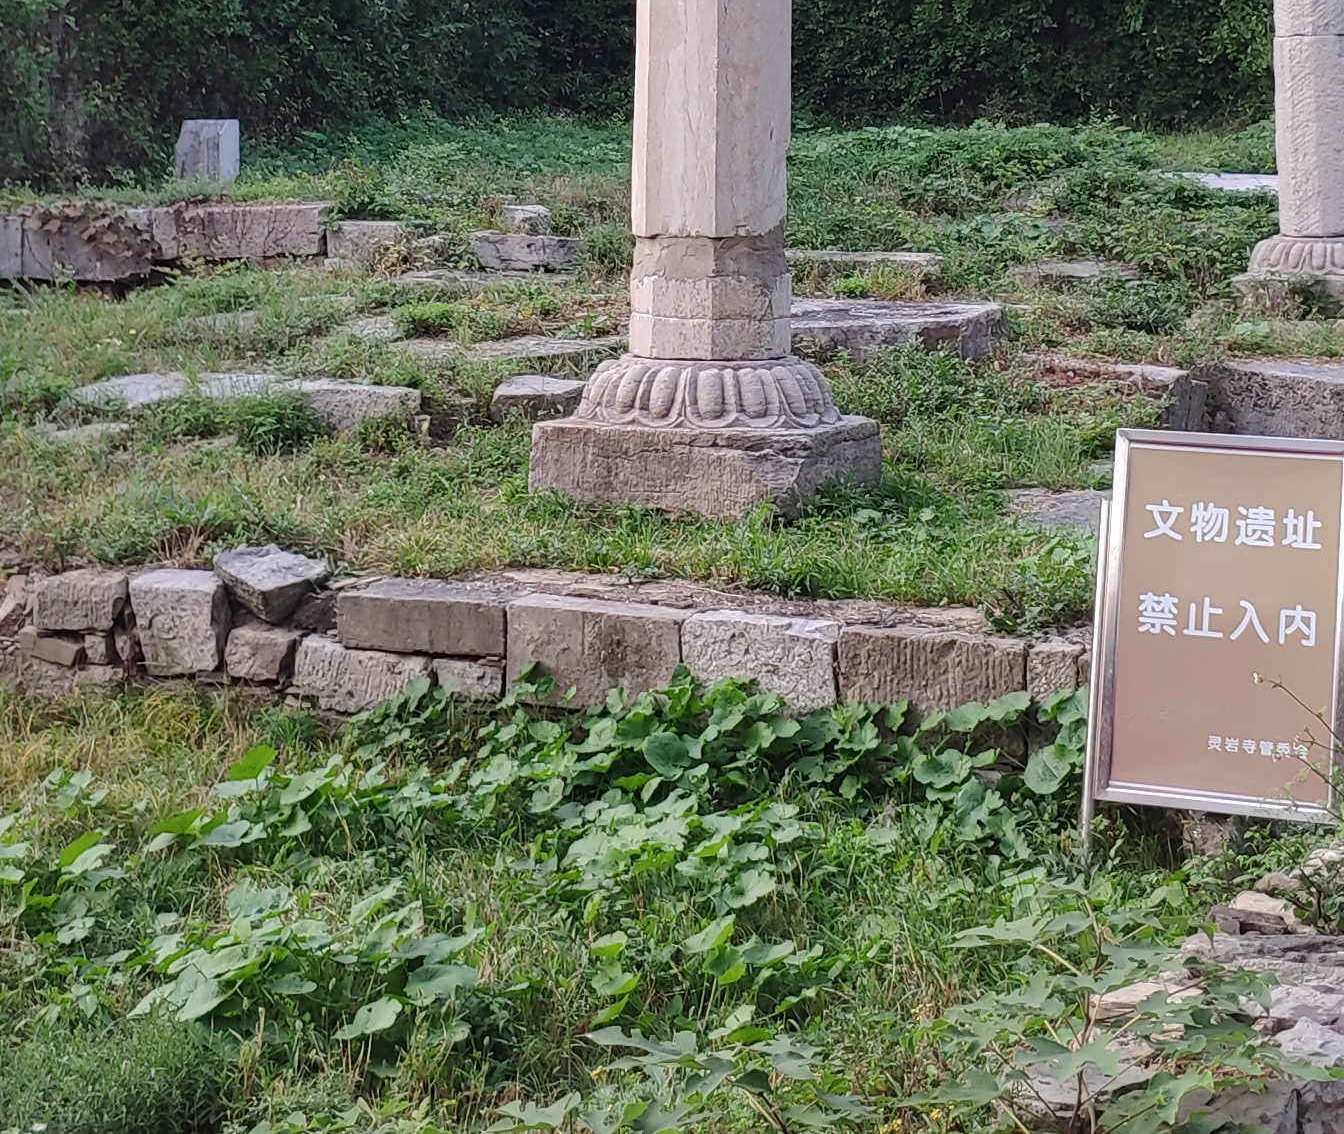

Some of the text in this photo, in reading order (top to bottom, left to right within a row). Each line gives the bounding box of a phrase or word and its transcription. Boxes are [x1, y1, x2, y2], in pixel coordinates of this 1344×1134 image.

[1143, 499, 1323, 550] 文物遗址
[1137, 591, 1317, 647] 禁止入内
[1207, 734, 1309, 760] 灵岩寺管委会
